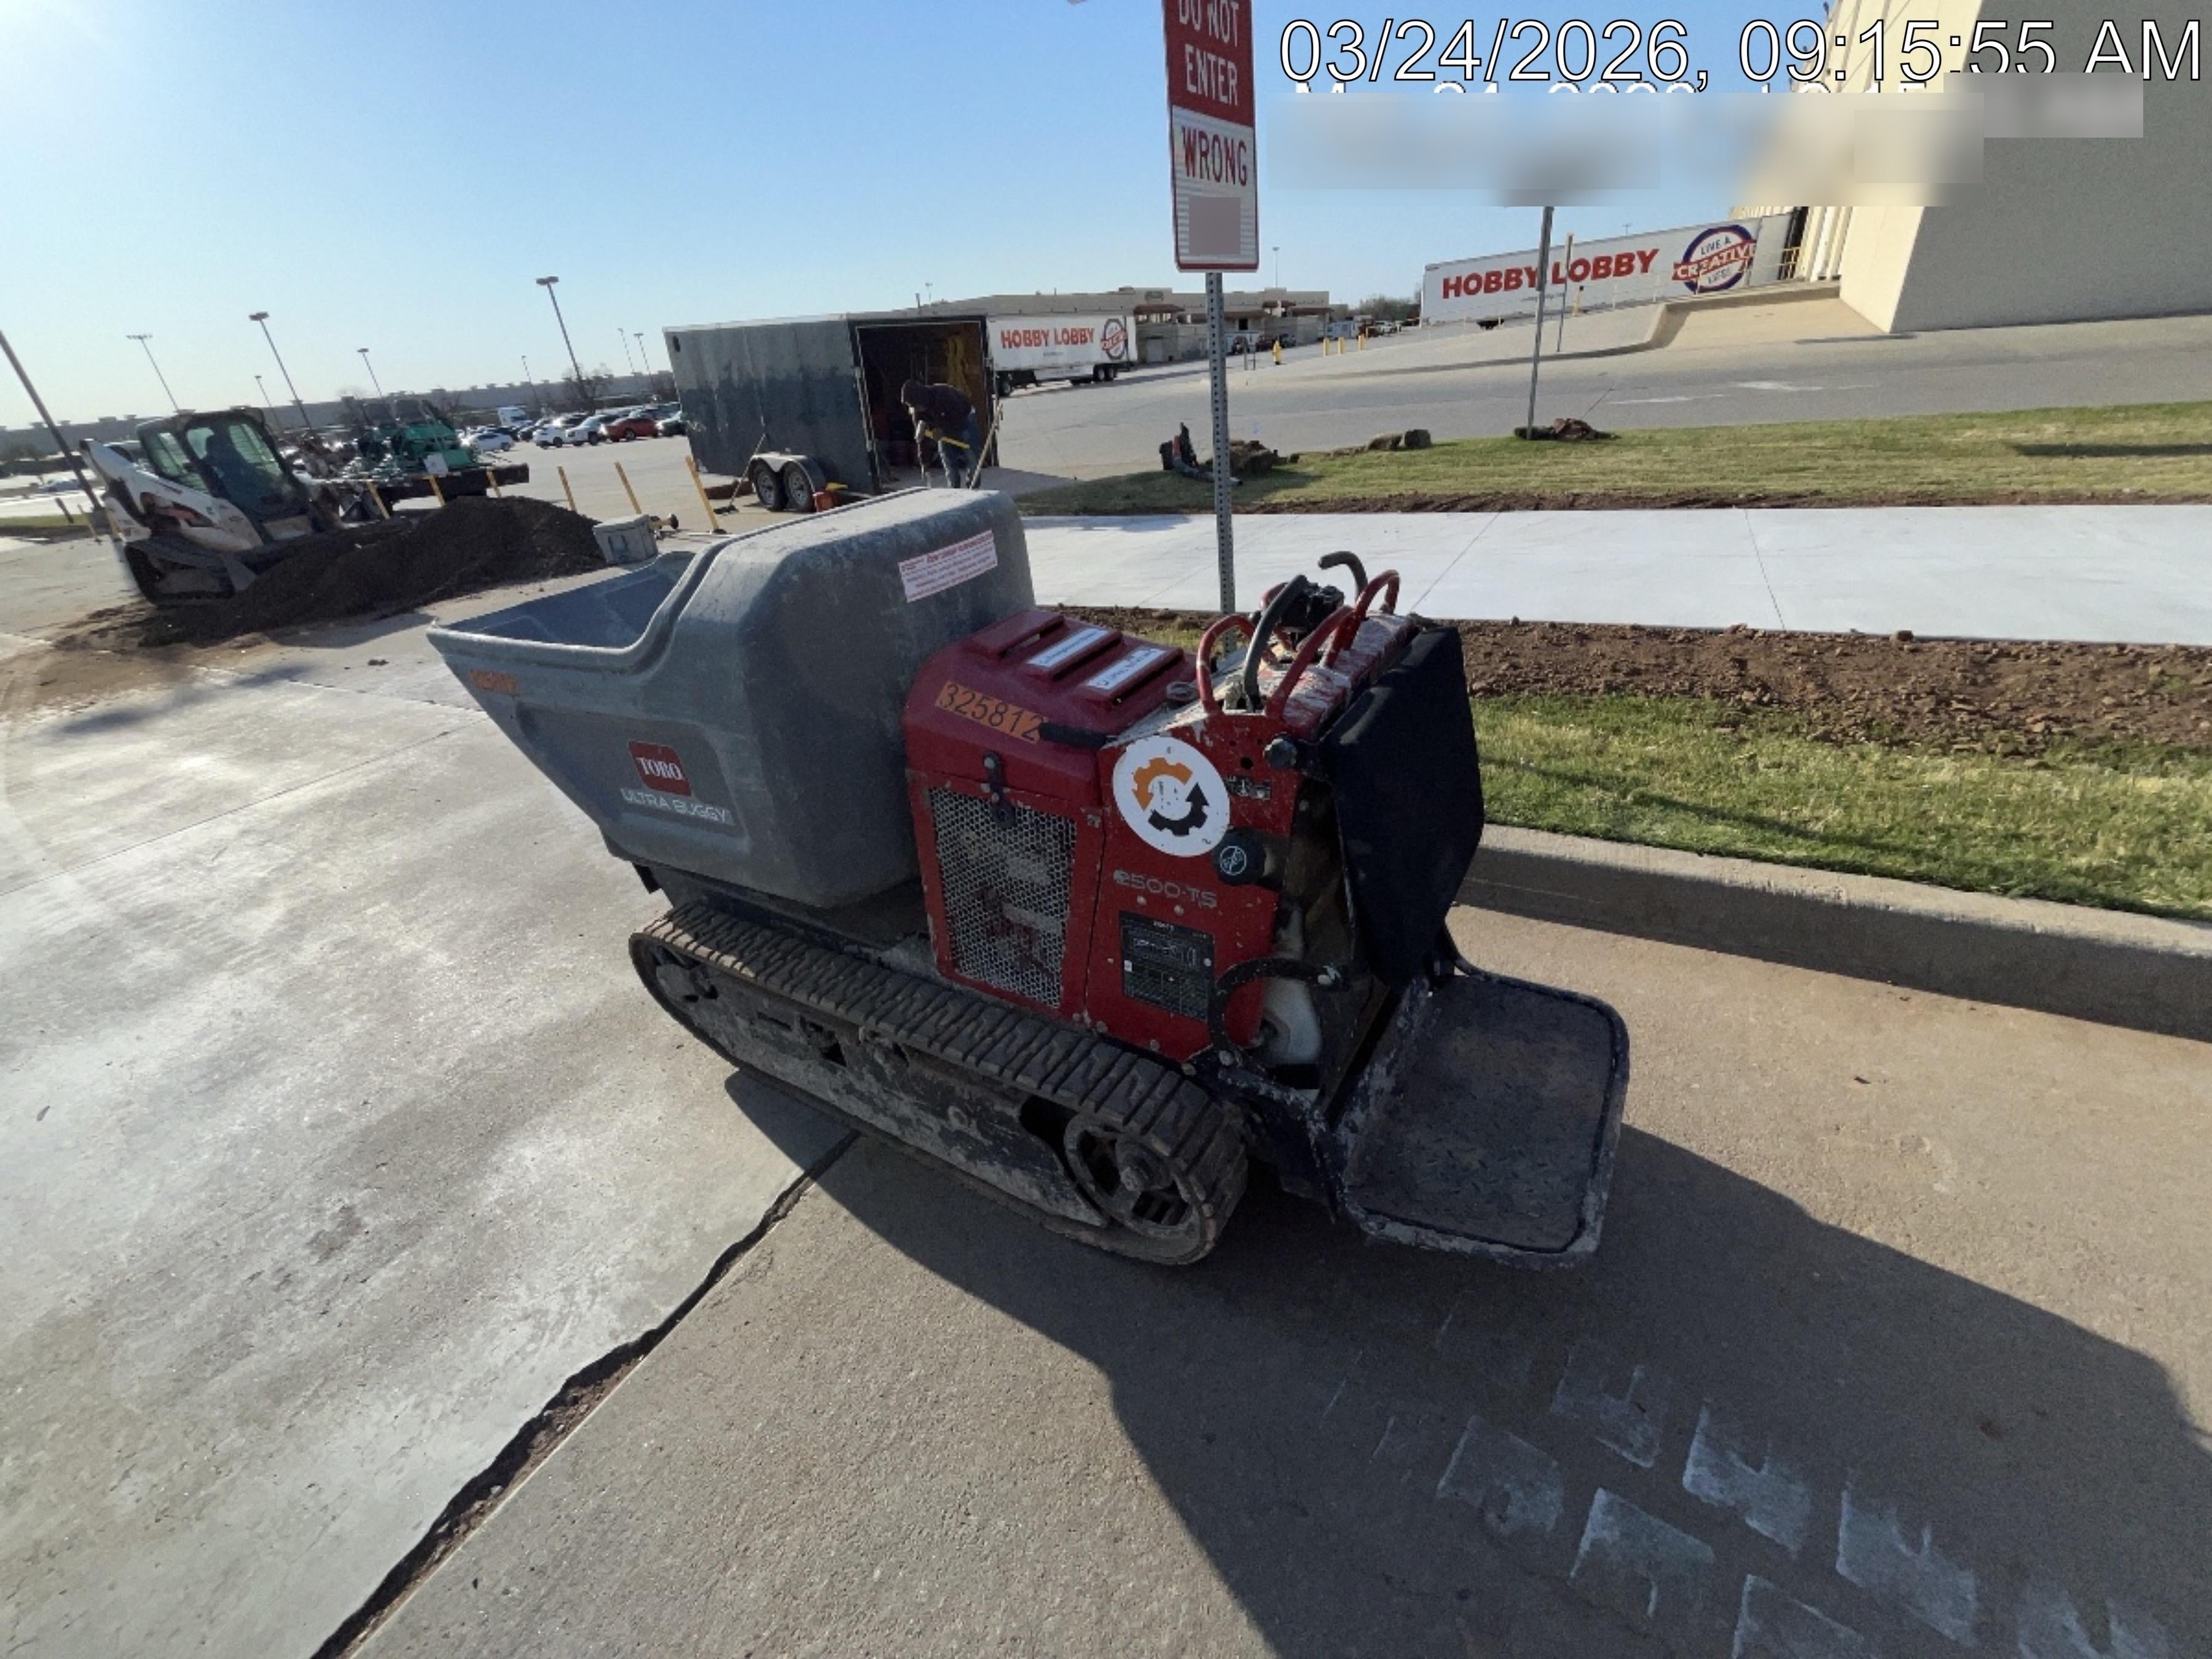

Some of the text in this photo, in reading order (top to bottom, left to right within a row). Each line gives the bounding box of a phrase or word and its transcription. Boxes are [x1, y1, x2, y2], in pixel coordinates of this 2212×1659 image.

[1207, 0, 1239, 47] NOT
[1184, 44, 1238, 106] ENTER
[1181, 126, 1248, 187] WRONG
[1442, 248, 1660, 299] HOBBY LOBBY
[1000, 329, 1049, 349] HOBBY
[1054, 327, 1095, 345] LOBBY
[939, 683, 1044, 742] 325812
[636, 756, 686, 781] TORO
[620, 787, 726, 823] ULTRA BUGGY
